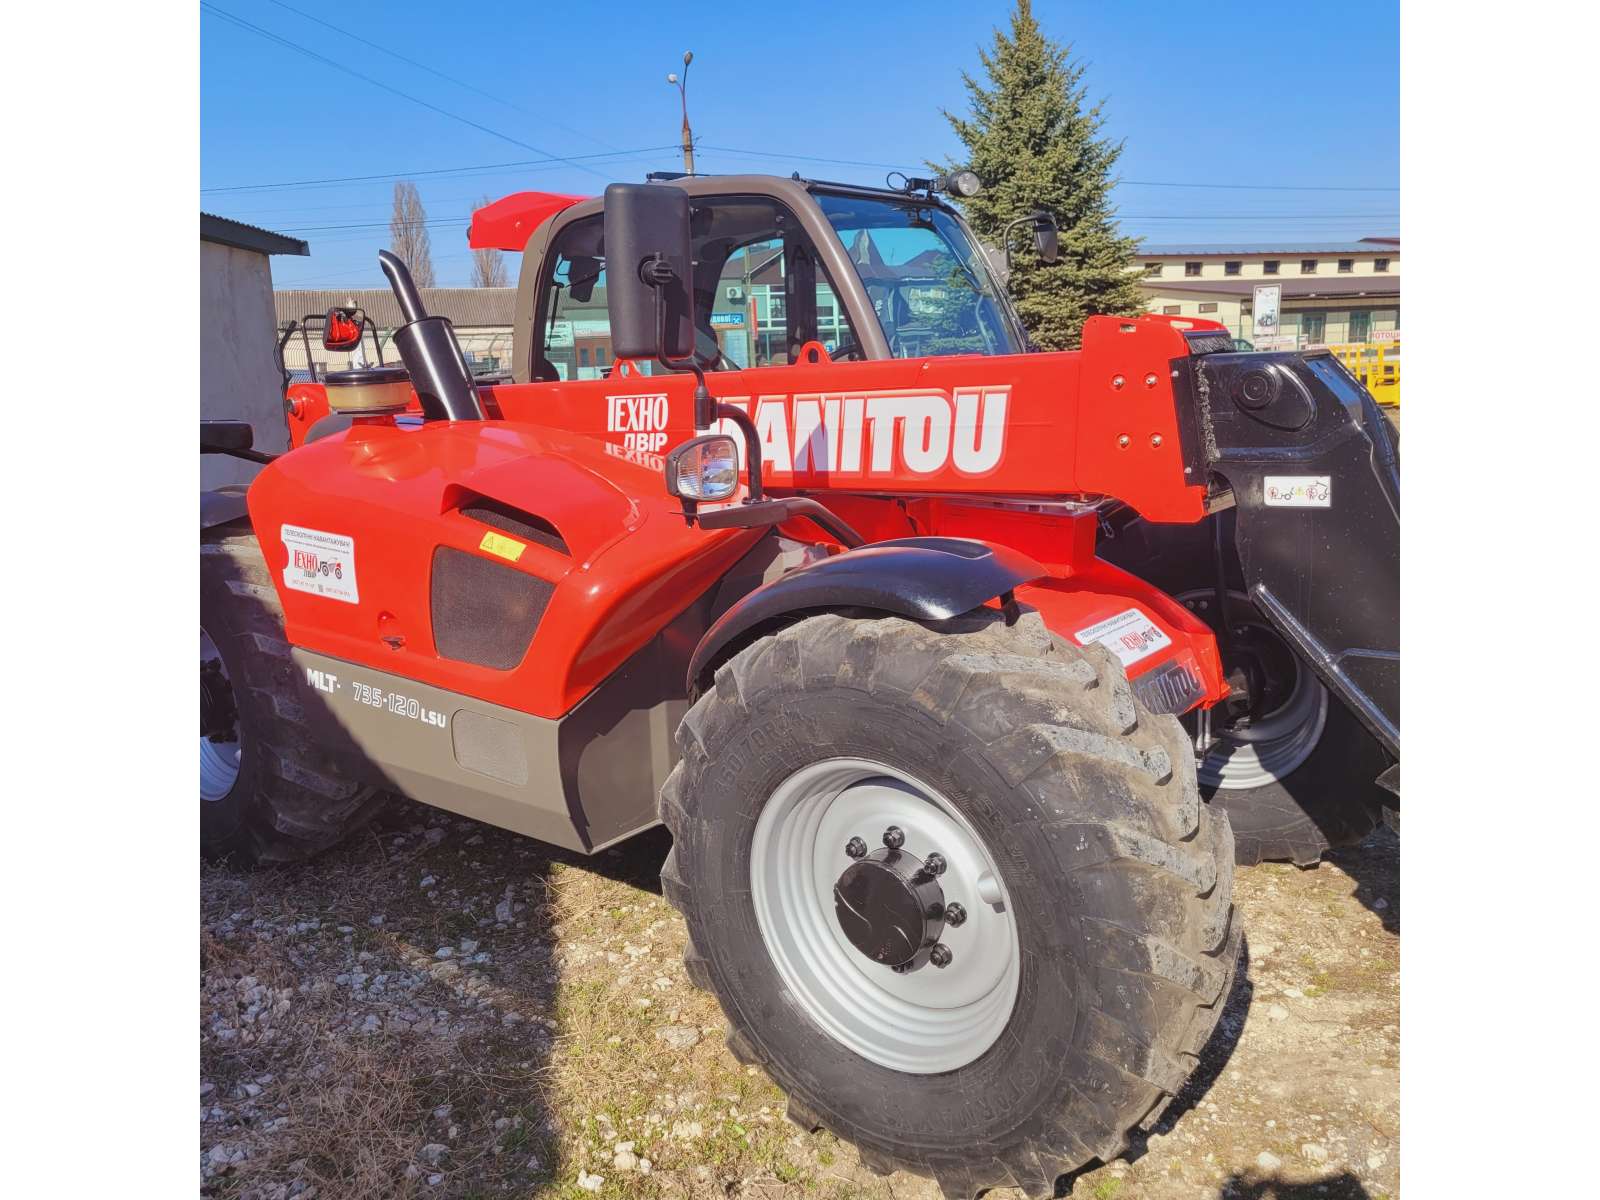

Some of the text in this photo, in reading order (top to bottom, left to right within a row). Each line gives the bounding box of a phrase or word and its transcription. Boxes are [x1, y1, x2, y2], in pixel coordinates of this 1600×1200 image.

[605, 393, 669, 432] ТЕХНО
[294, 549, 318, 572] ТЕХНО
[420, 708, 447, 728] LSU
